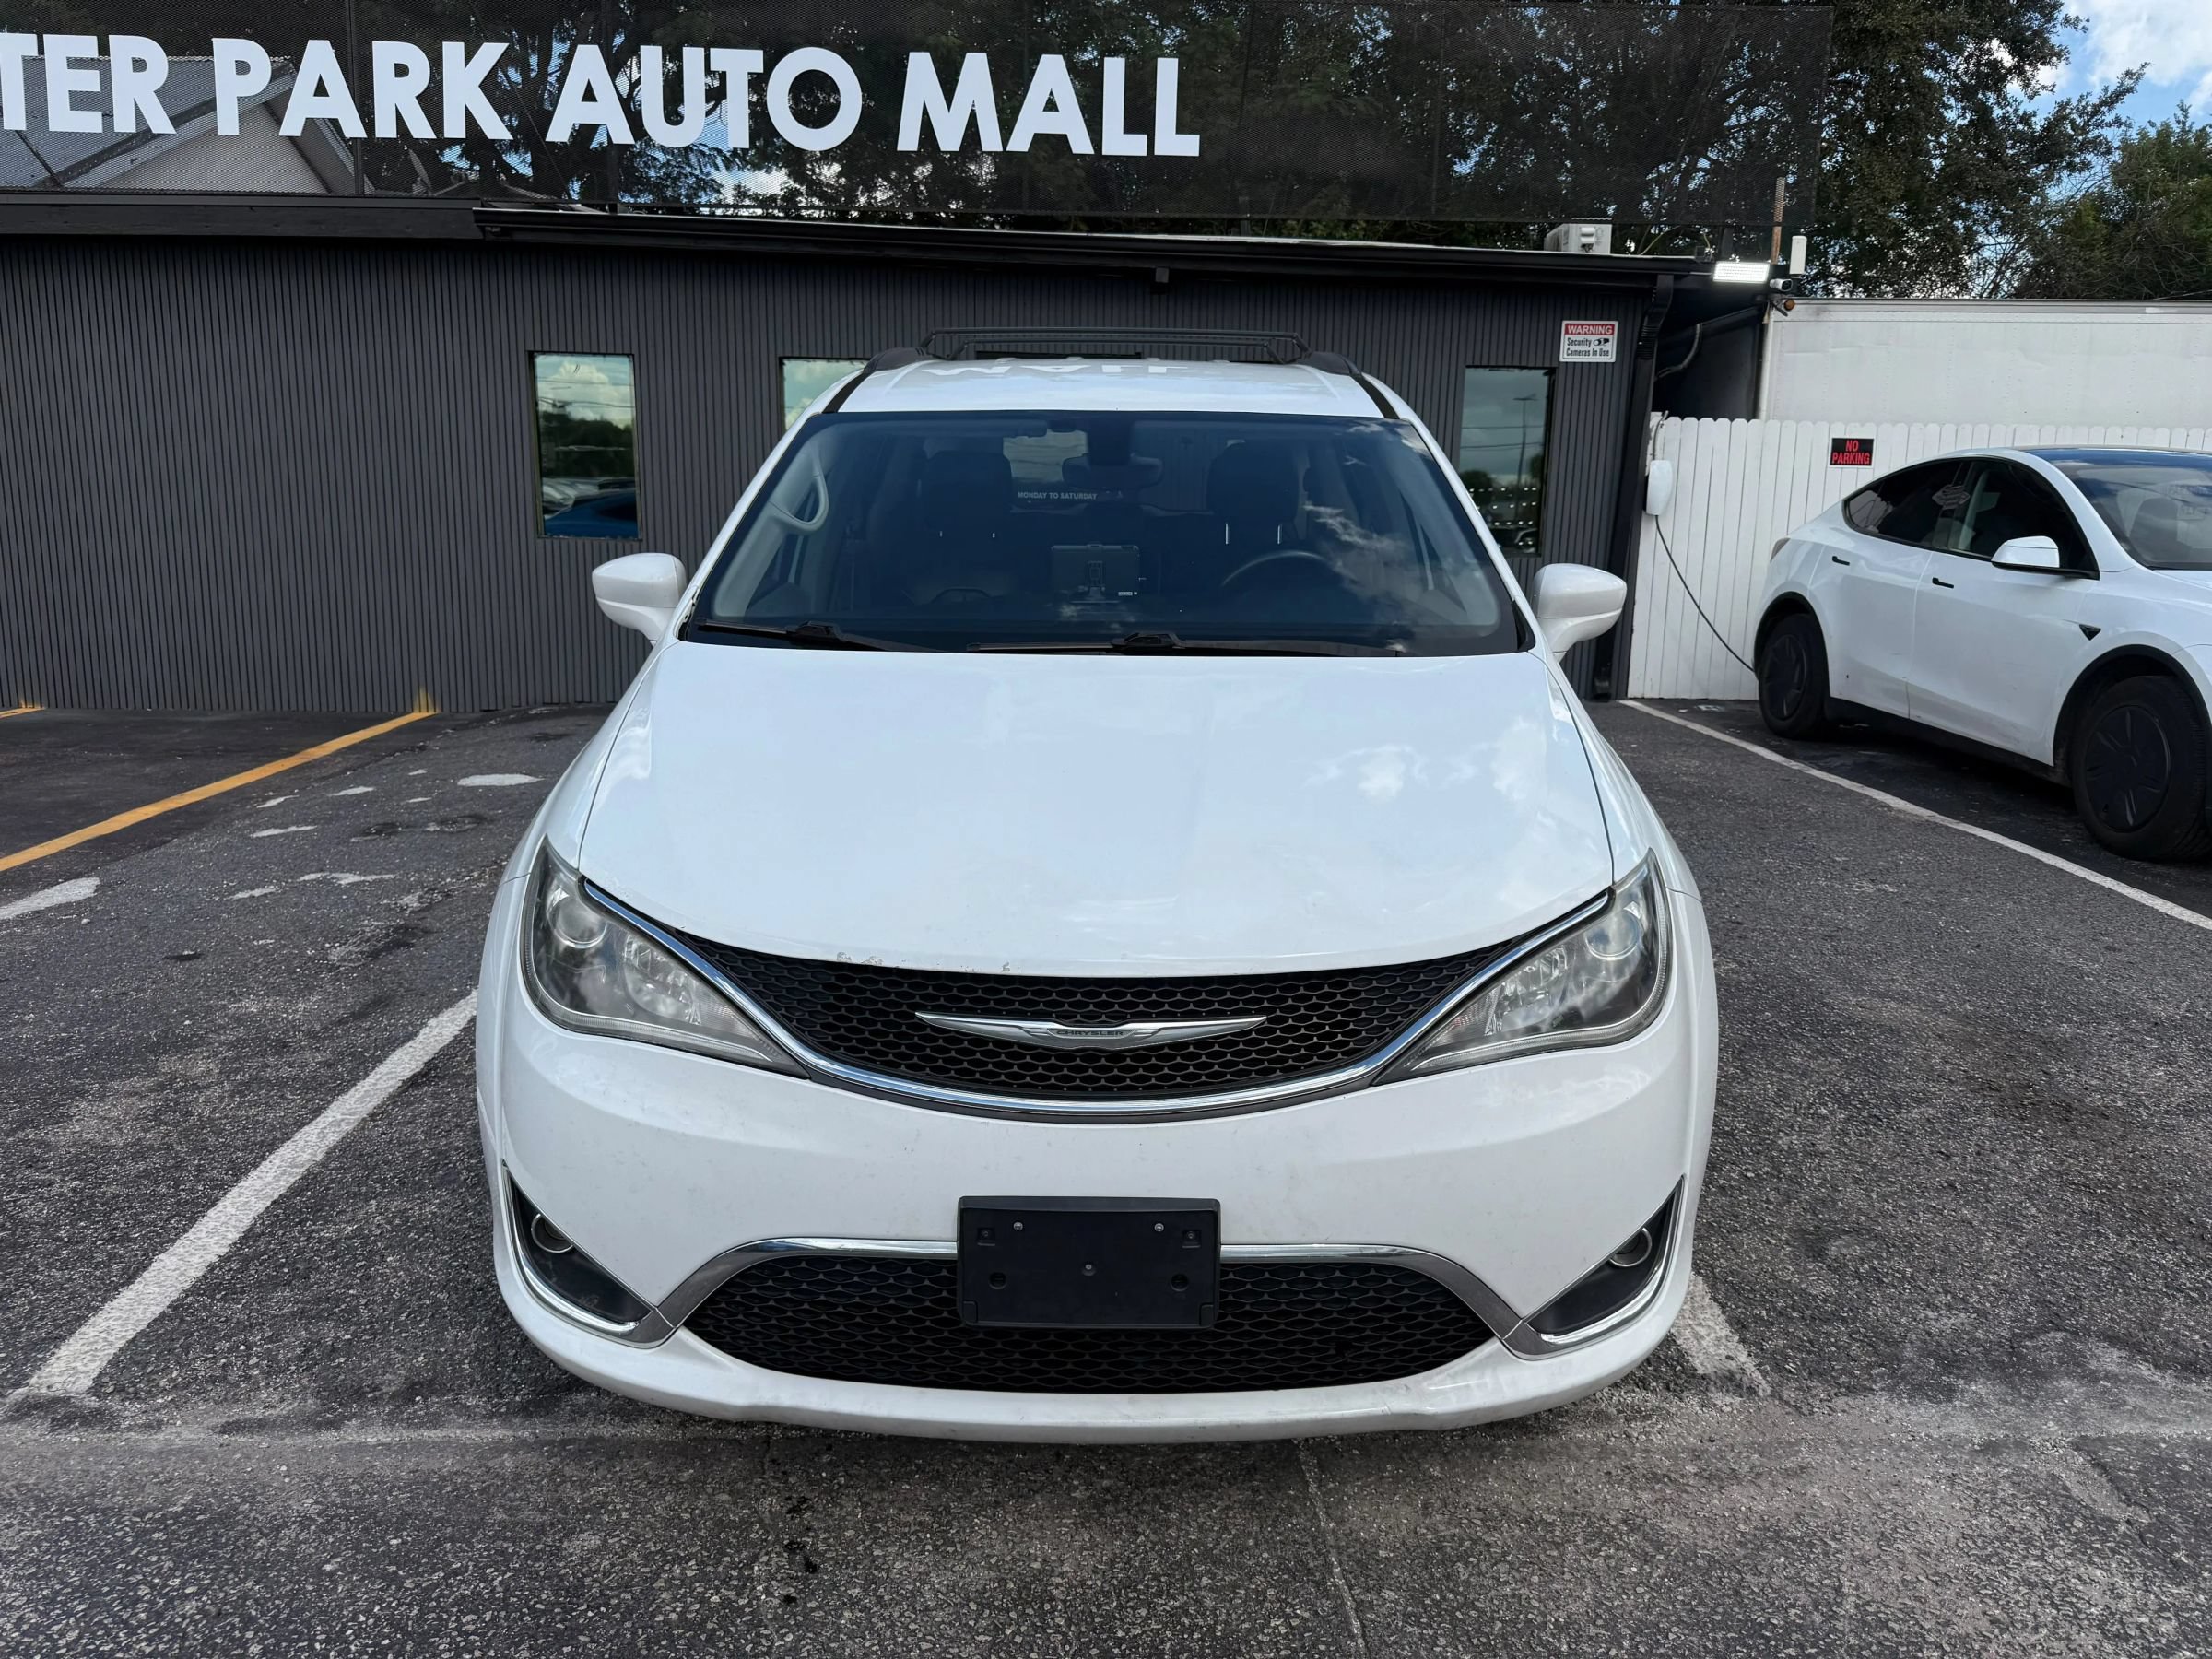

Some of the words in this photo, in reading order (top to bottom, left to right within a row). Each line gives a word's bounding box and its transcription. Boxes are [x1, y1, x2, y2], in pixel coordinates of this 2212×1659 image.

[212, 37, 513, 140] PARK
[545, 44, 863, 151] AUTO
[897, 51, 1200, 157] MALL
[1567, 325, 1612, 334] WARNING
[1567, 337, 1592, 347] Security
[1566, 348, 1591, 357] Cameras
[1599, 348, 1609, 357] Use
[1845, 440, 1859, 452] NO
[1831, 452, 1870, 465] PARKING
